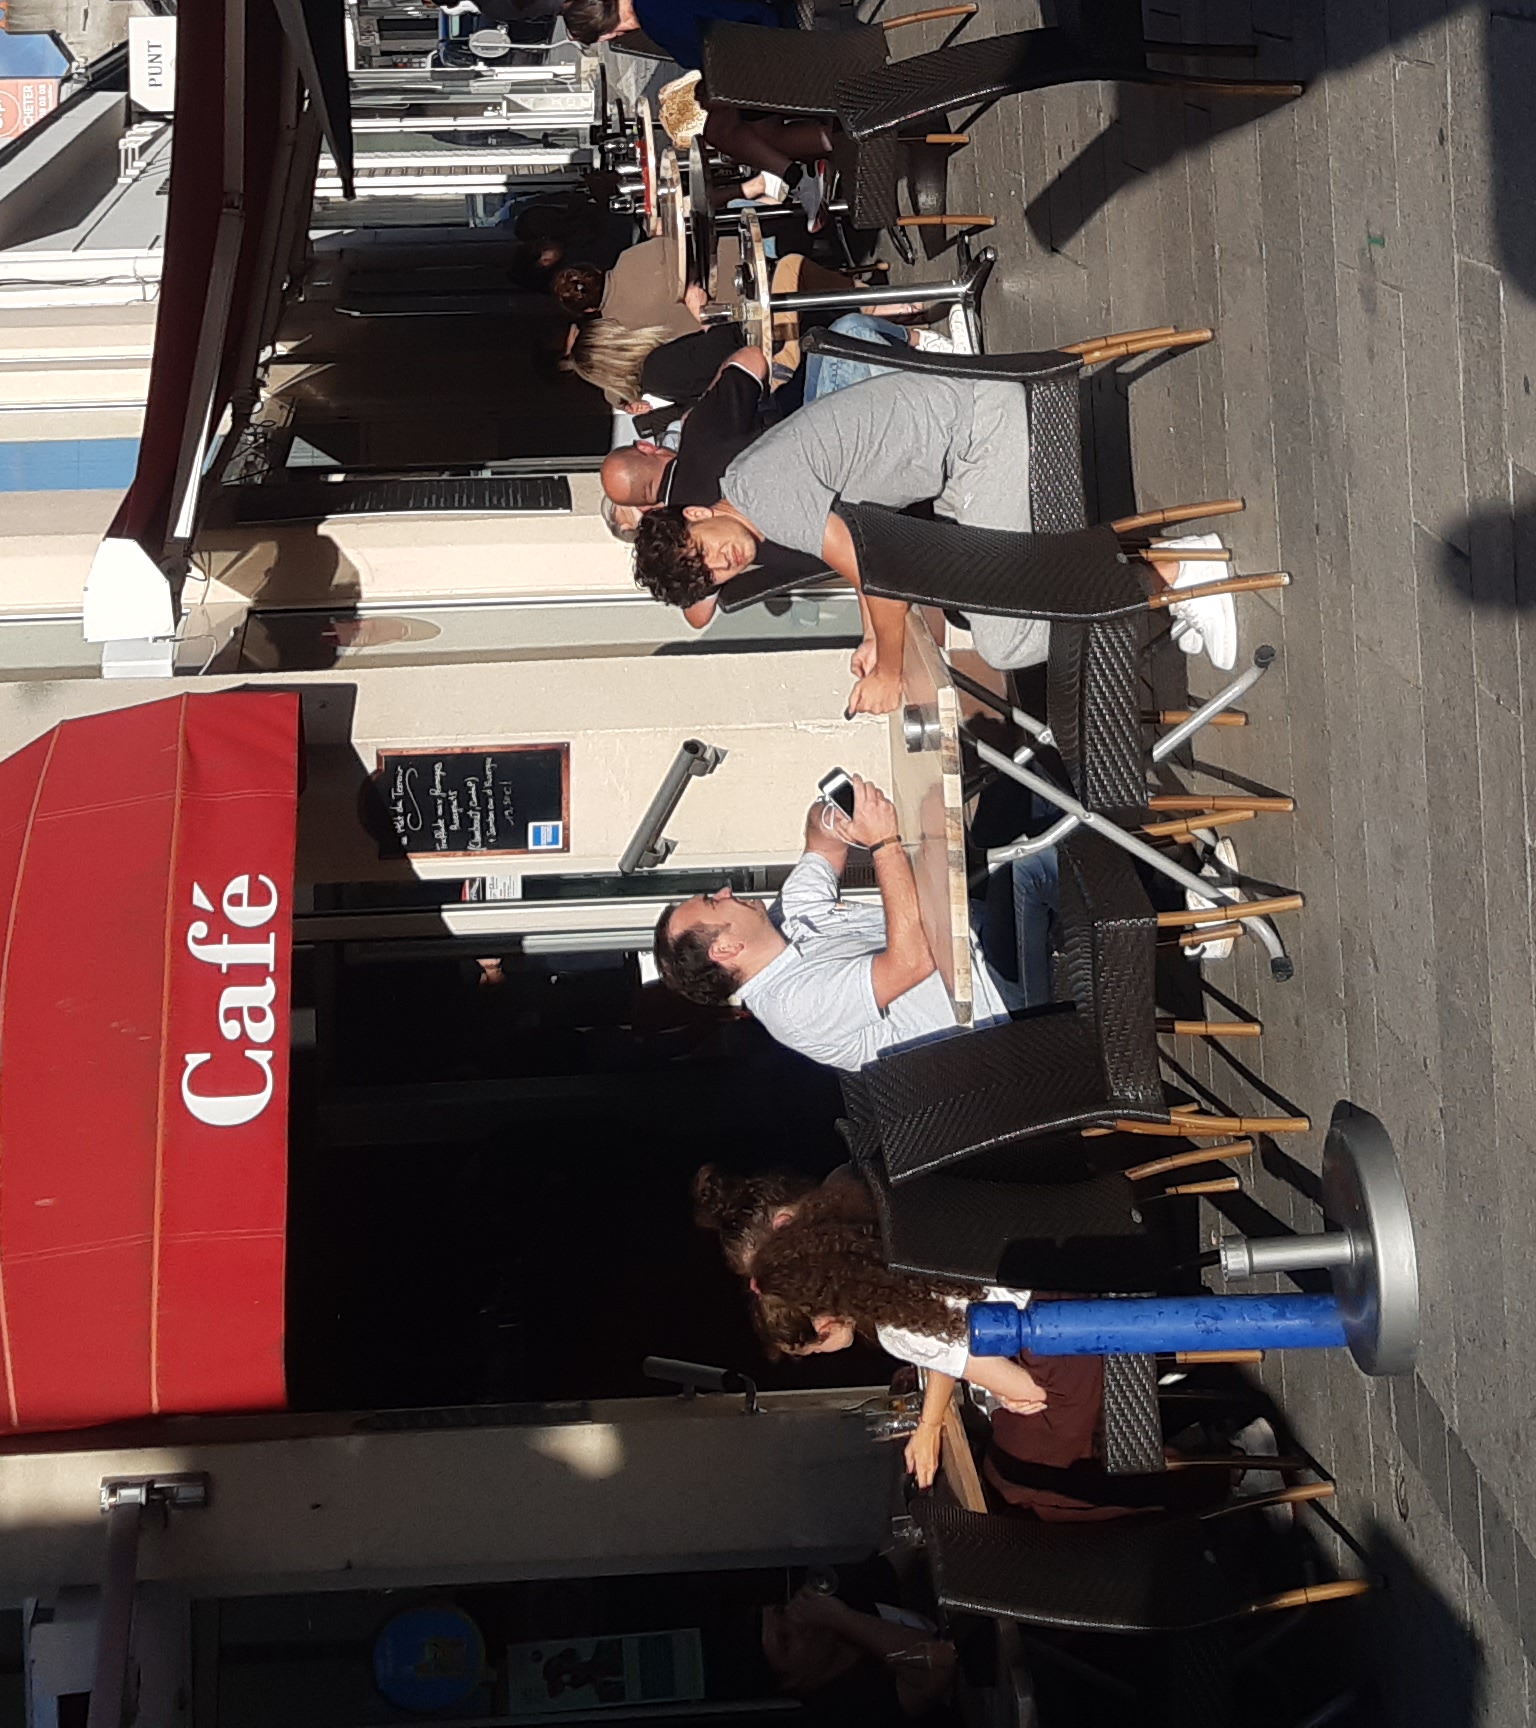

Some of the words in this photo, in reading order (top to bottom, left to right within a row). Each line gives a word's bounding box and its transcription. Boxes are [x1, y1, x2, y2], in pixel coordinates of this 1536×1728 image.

[147, 40, 163, 88] PUNT
[23, 85, 34, 130] CHETER
[181, 873, 279, 1127] Café
